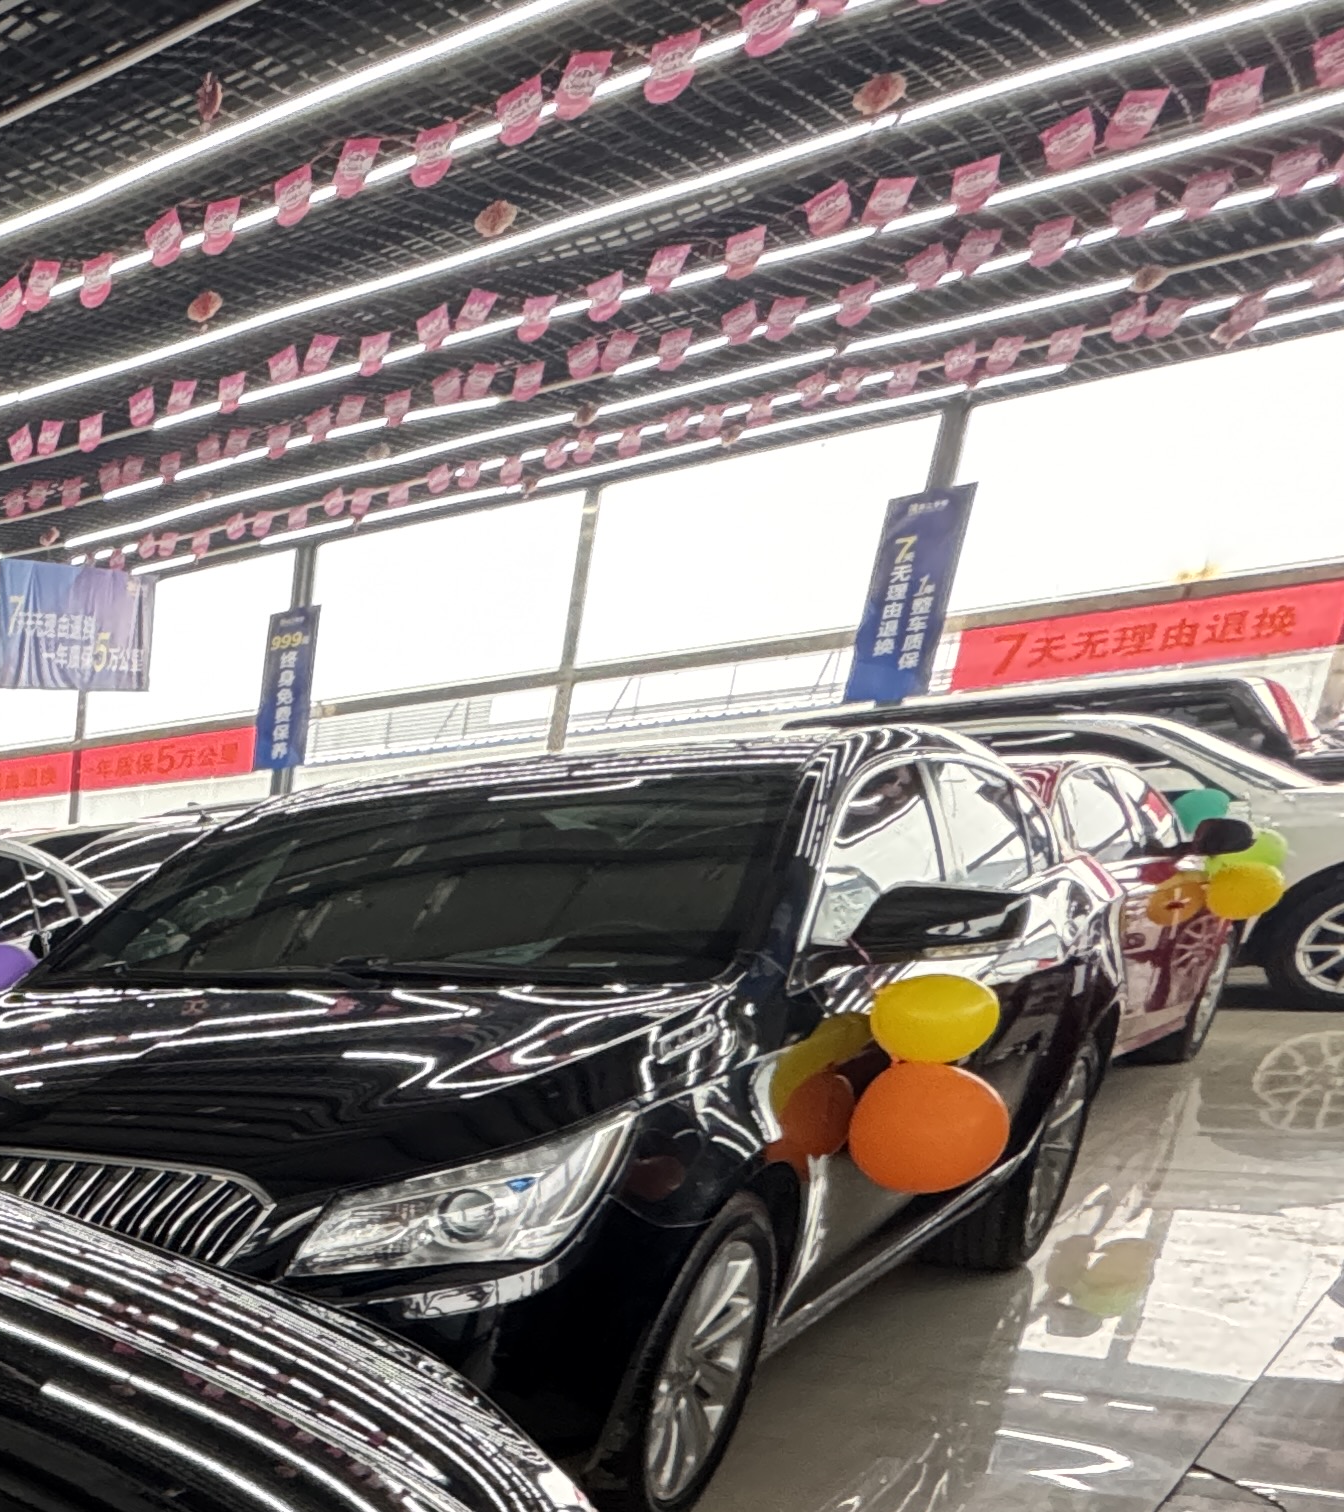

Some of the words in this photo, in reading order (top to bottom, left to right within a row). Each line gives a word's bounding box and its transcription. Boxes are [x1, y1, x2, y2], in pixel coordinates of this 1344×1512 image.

[992, 604, 1297, 677] 7天无理由退换
